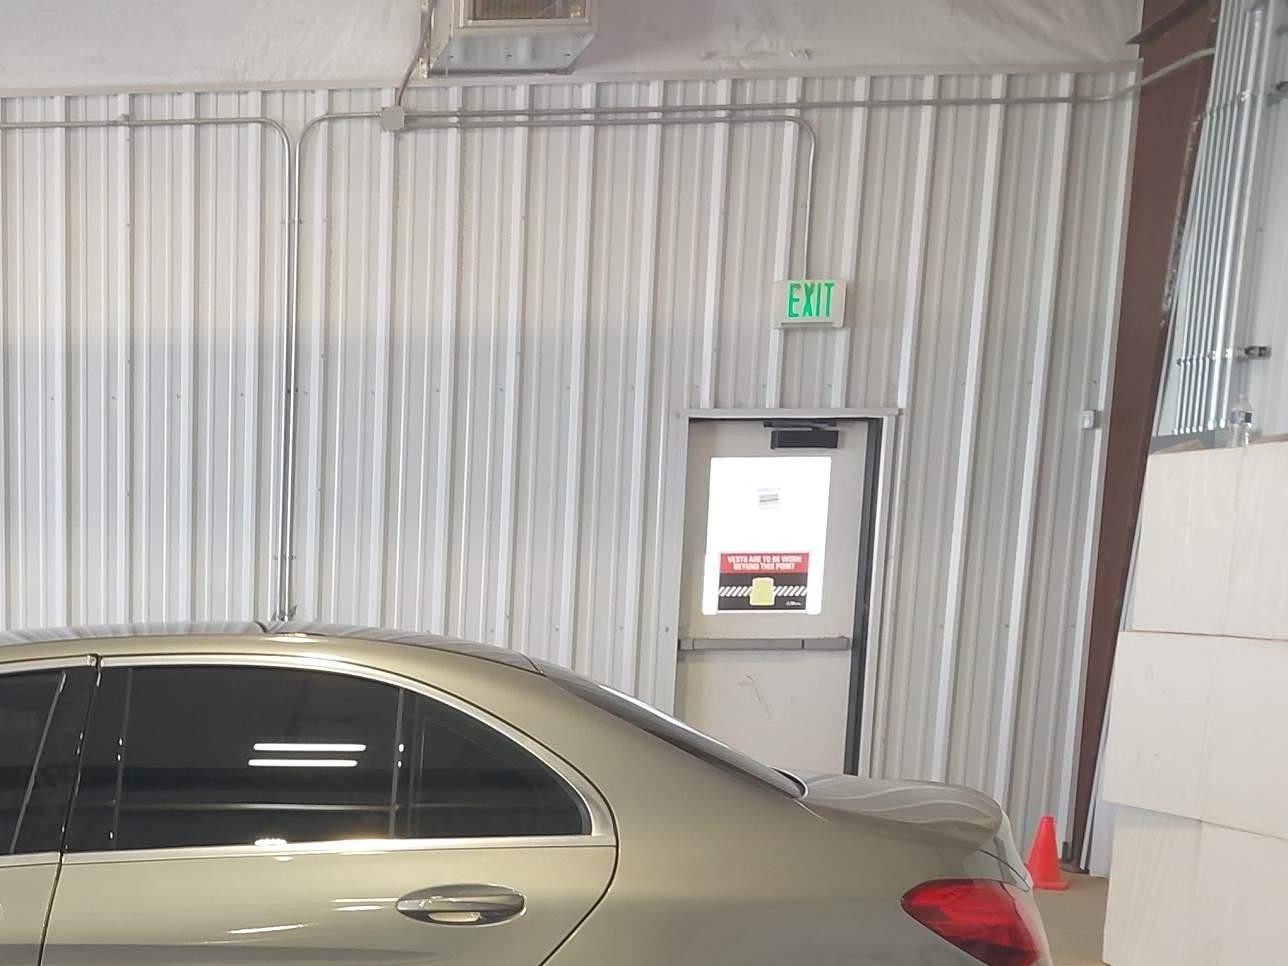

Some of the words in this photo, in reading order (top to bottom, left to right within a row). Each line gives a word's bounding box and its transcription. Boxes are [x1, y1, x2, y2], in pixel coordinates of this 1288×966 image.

[788, 282, 835, 317] EXIT
[748, 555, 761, 563] ARE
[762, 555, 771, 563] TO
[775, 563, 796, 571] POINT
